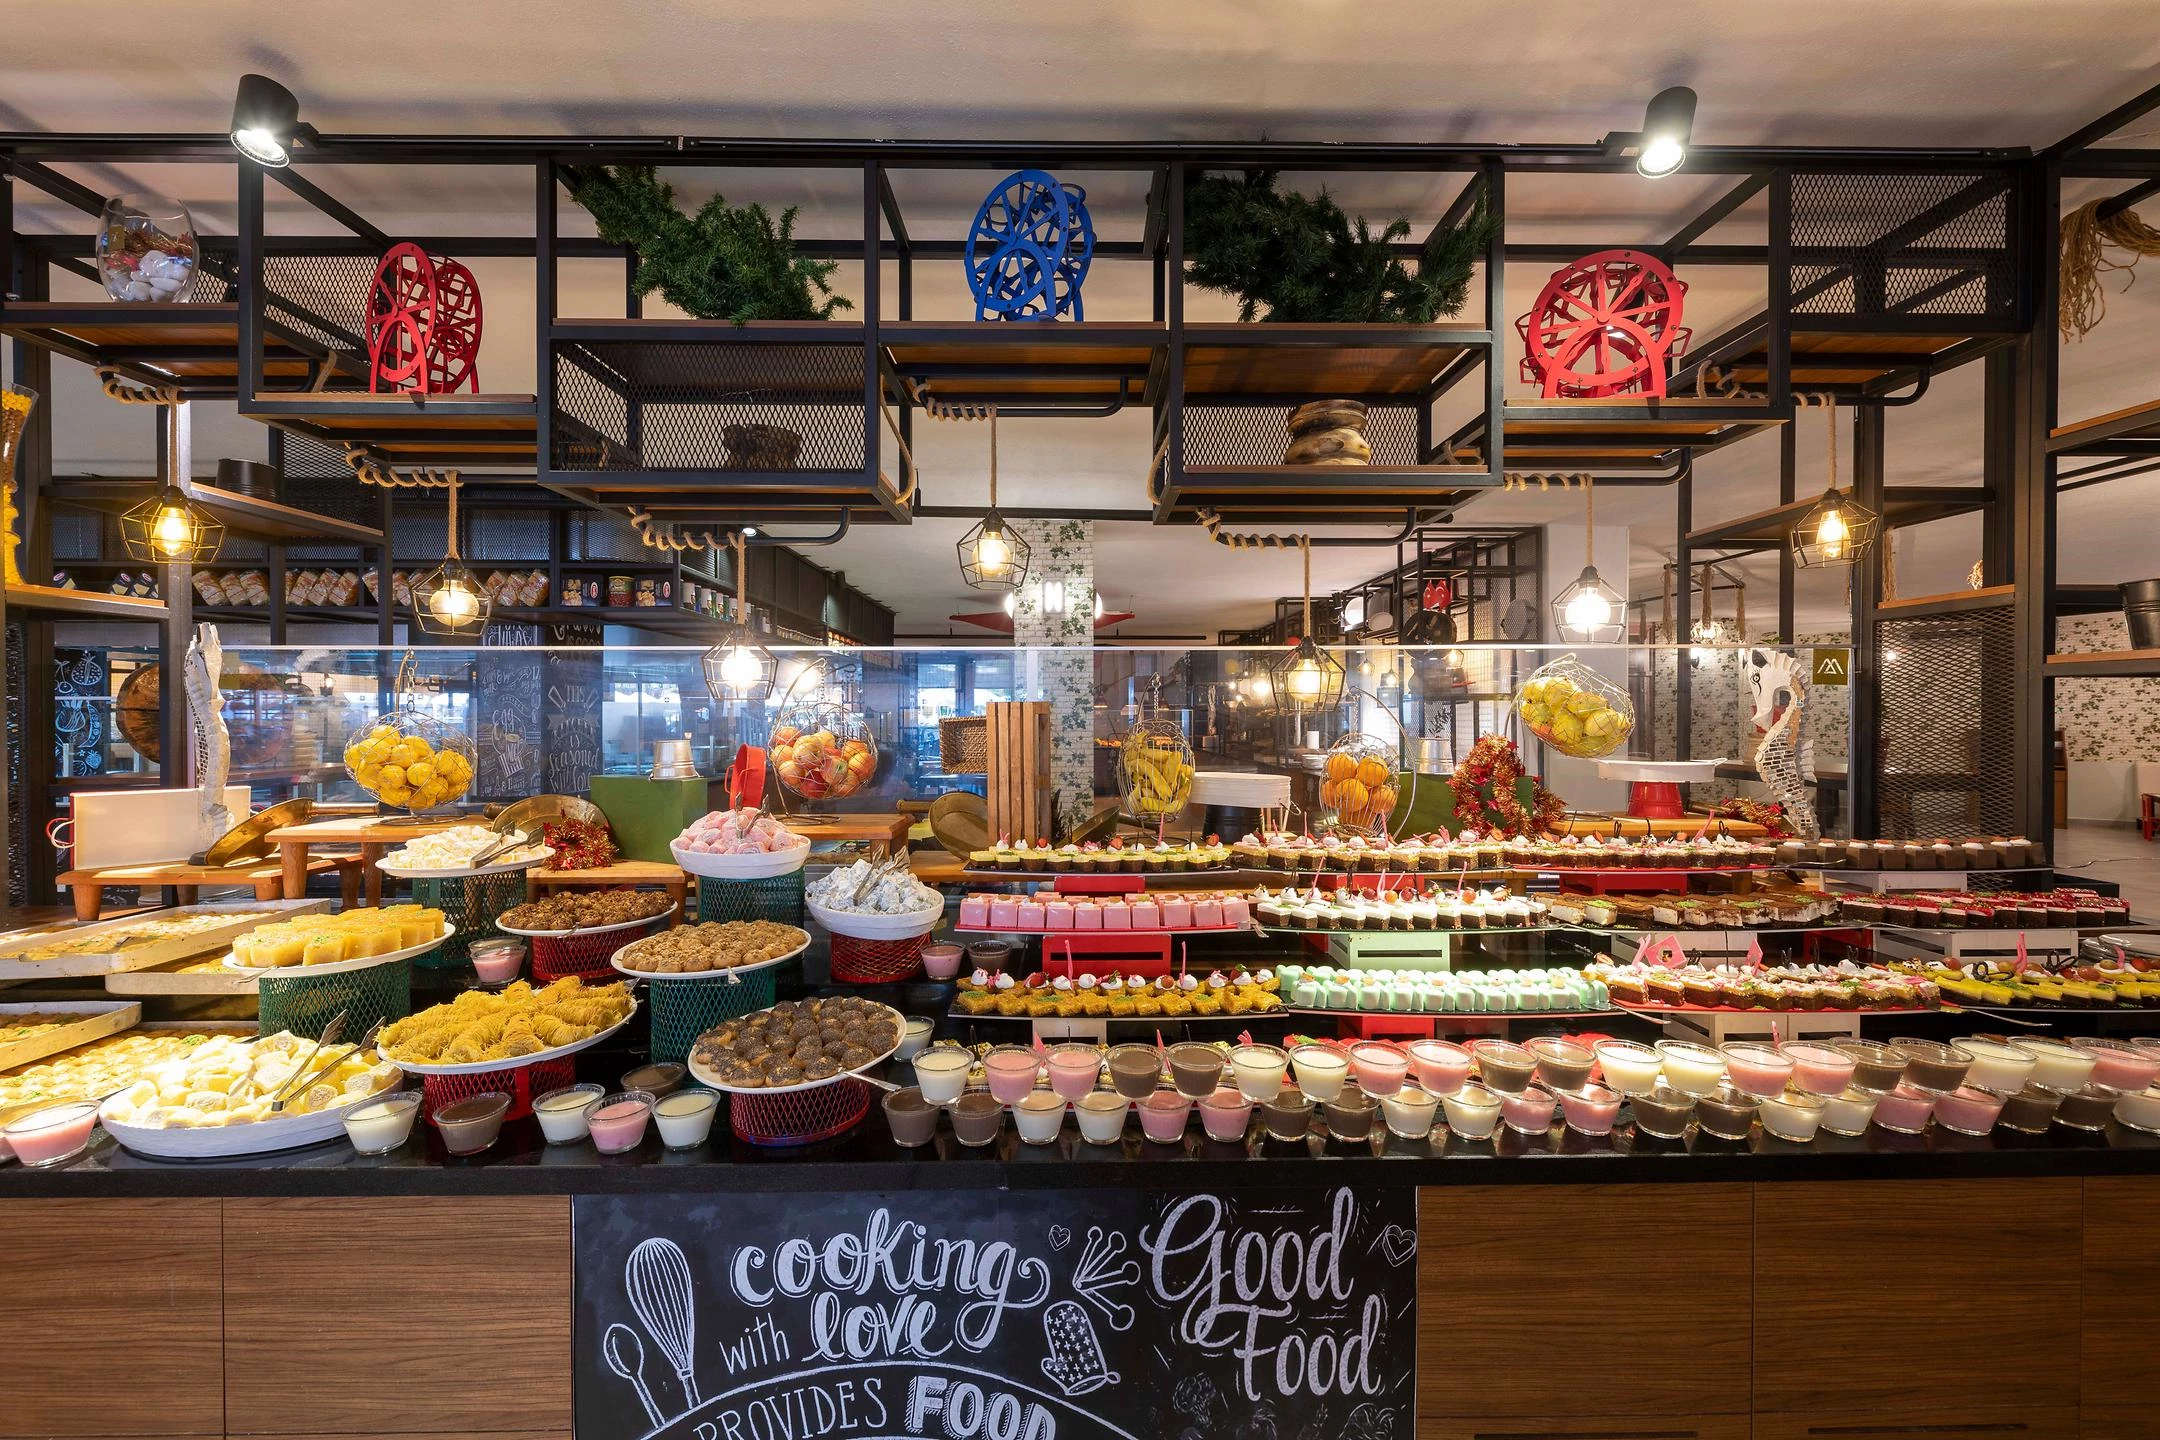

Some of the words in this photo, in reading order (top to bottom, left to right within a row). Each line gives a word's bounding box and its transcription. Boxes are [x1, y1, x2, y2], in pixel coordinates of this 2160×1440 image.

[549, 747, 600, 778] seasoned
[572, 765, 591, 791] lov
[731, 1207, 1051, 1351] cooking
[1139, 1186, 1354, 1344] Good
[719, 1313, 790, 1375] with
[801, 1291, 954, 1362] love
[1194, 1294, 1381, 1401] Food
[905, 1375, 1056, 1440] FOOD
